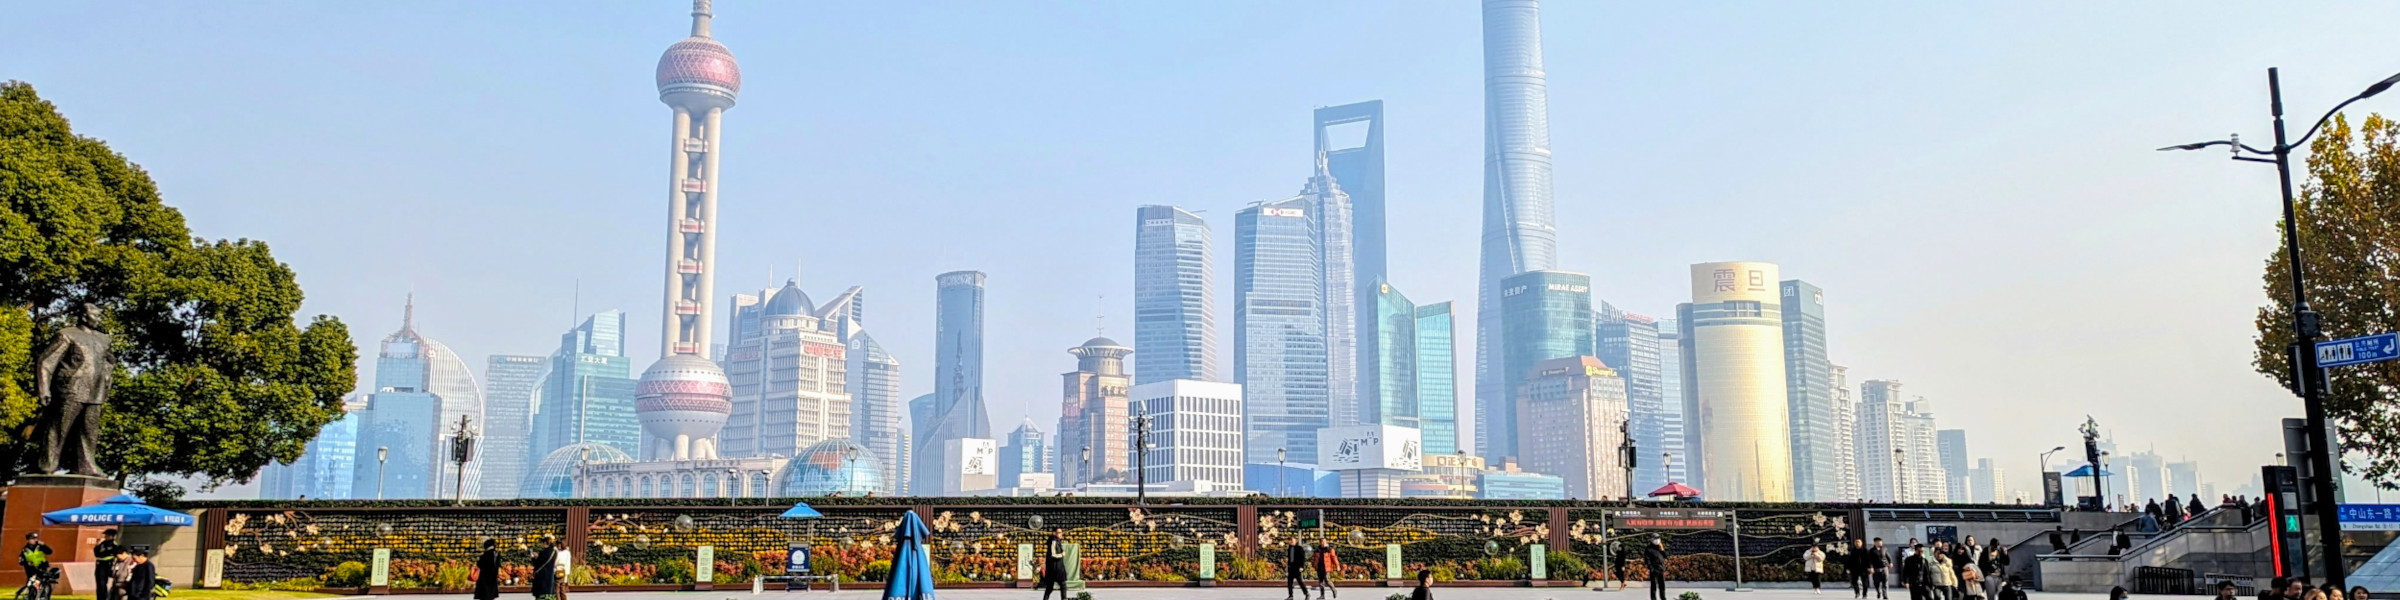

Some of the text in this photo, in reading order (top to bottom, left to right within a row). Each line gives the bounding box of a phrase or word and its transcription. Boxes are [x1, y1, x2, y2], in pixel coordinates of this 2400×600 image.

[1713, 268, 1766, 292] 震旦
[2358, 351, 2378, 359] 100m
[81, 514, 113, 522] POLICE
[1928, 526, 1937, 534] 05
